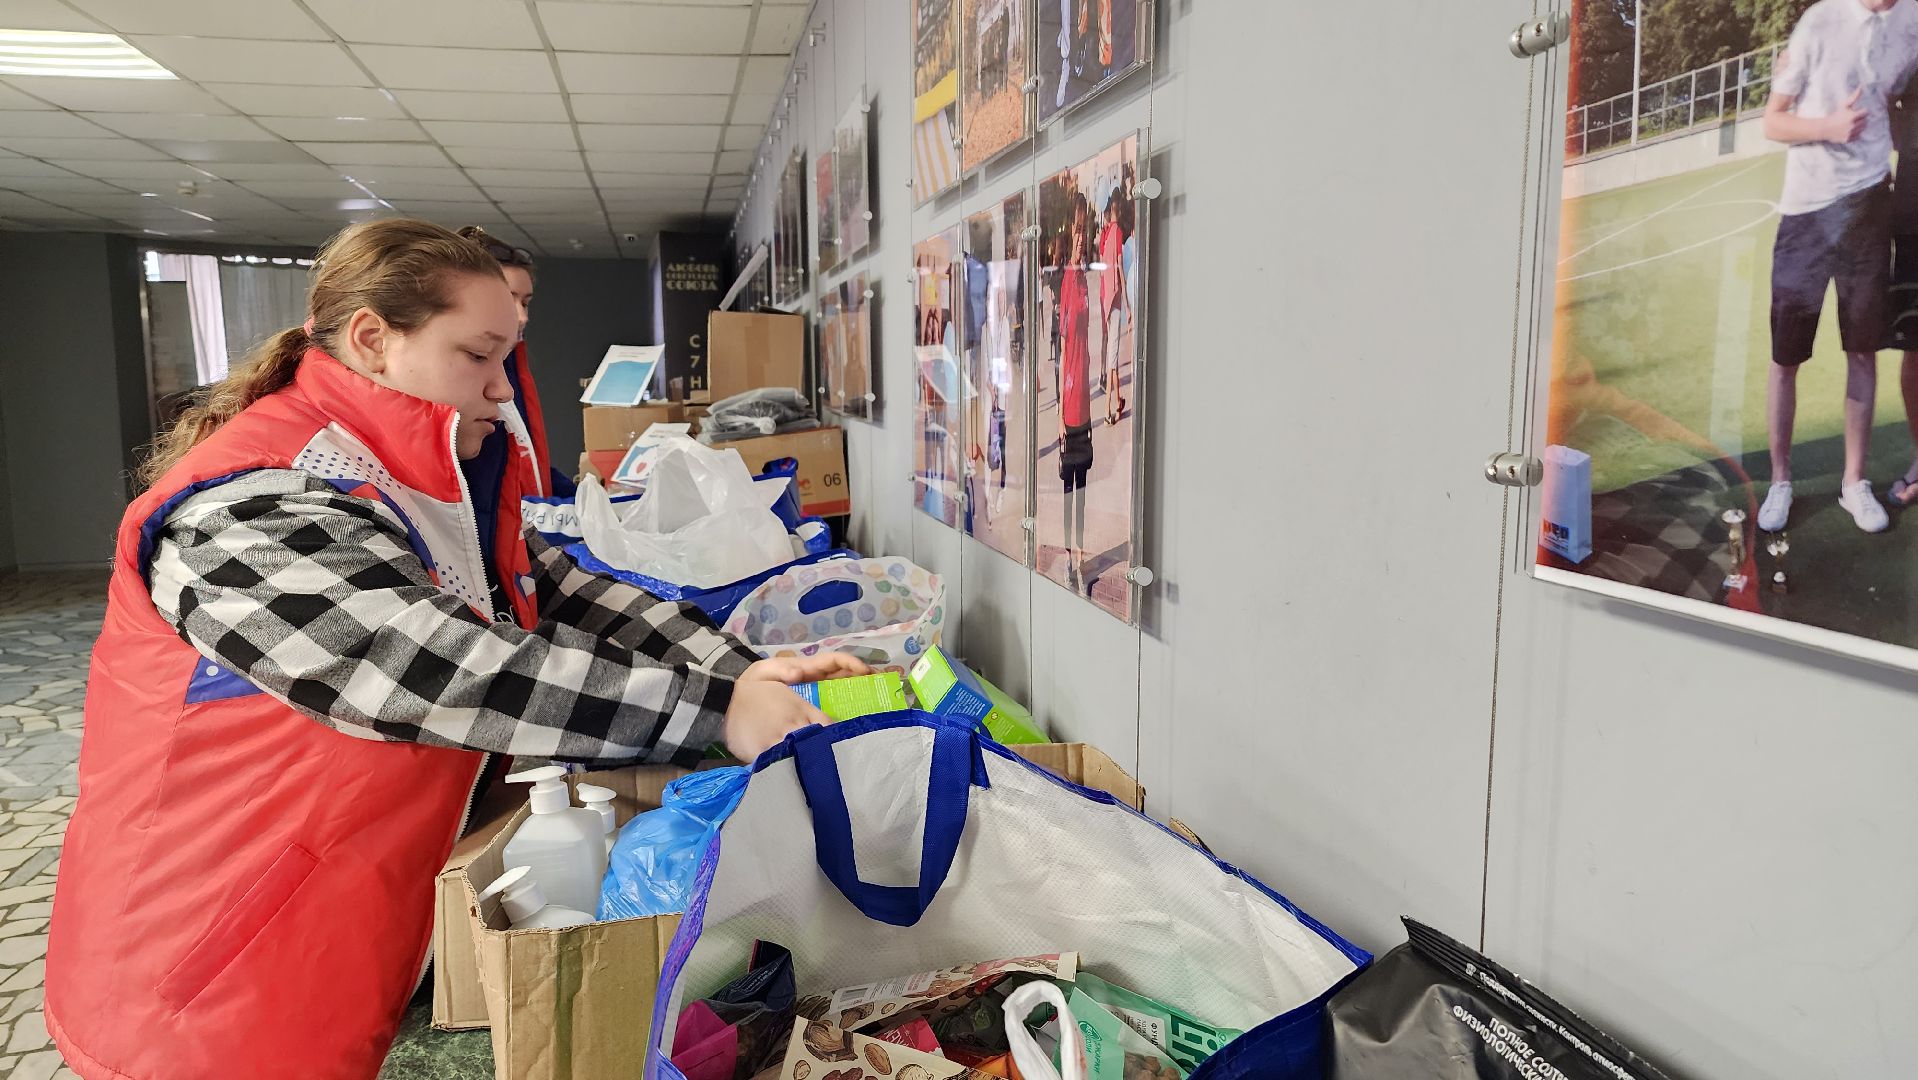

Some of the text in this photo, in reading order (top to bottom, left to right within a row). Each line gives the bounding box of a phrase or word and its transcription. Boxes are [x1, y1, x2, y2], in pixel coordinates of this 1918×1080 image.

[690, 355, 701, 369] 7
[823, 473, 842, 487] 06
[1453, 1005, 1545, 1080] ФИЗИОЛОГИЧЕСКИ
[1489, 1017, 1536, 1060] ПОЛНОЕ
[1592, 1051, 1637, 1080] атмосфер
